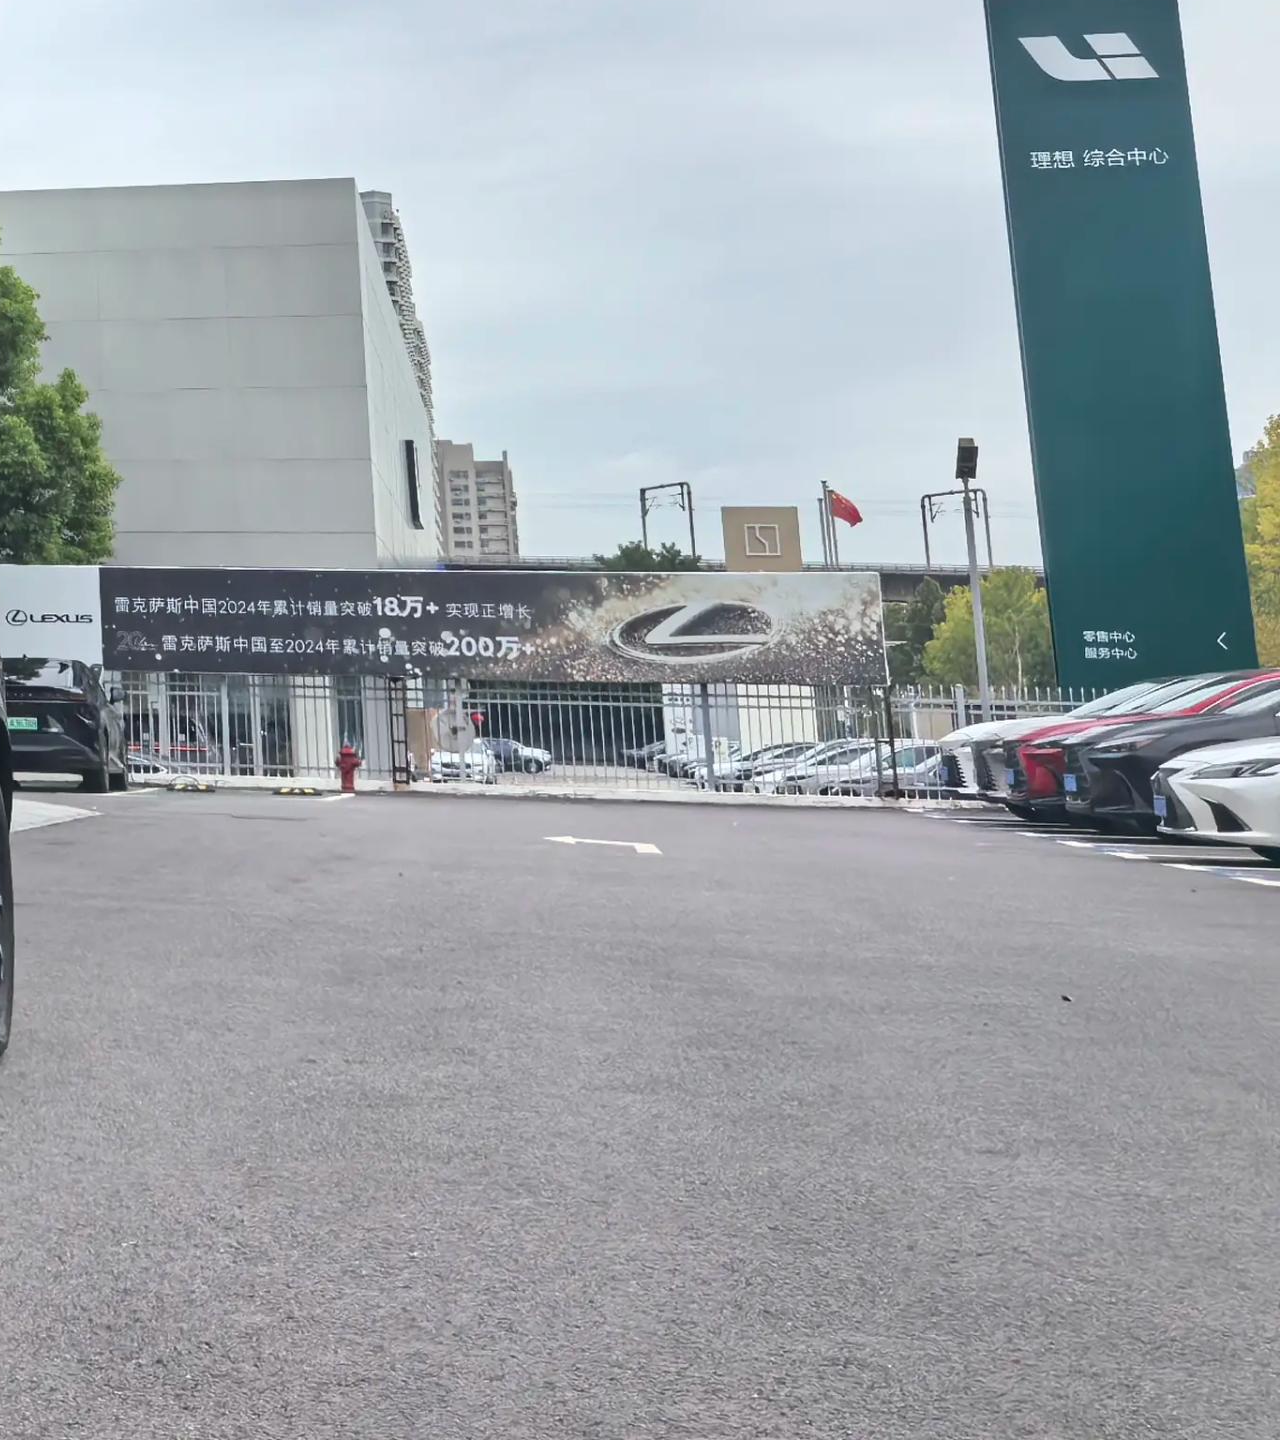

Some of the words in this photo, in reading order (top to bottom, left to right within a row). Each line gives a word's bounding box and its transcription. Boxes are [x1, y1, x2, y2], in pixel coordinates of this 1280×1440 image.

[1030, 151, 1075, 169] 理想
[1083, 147, 1169, 168] 综合中心
[446, 602, 532, 620] 实现正增长
[29, 613, 93, 624] LEXUS
[1083, 630, 1136, 644] 零售中心
[1084, 646, 1138, 660] 服务中心
